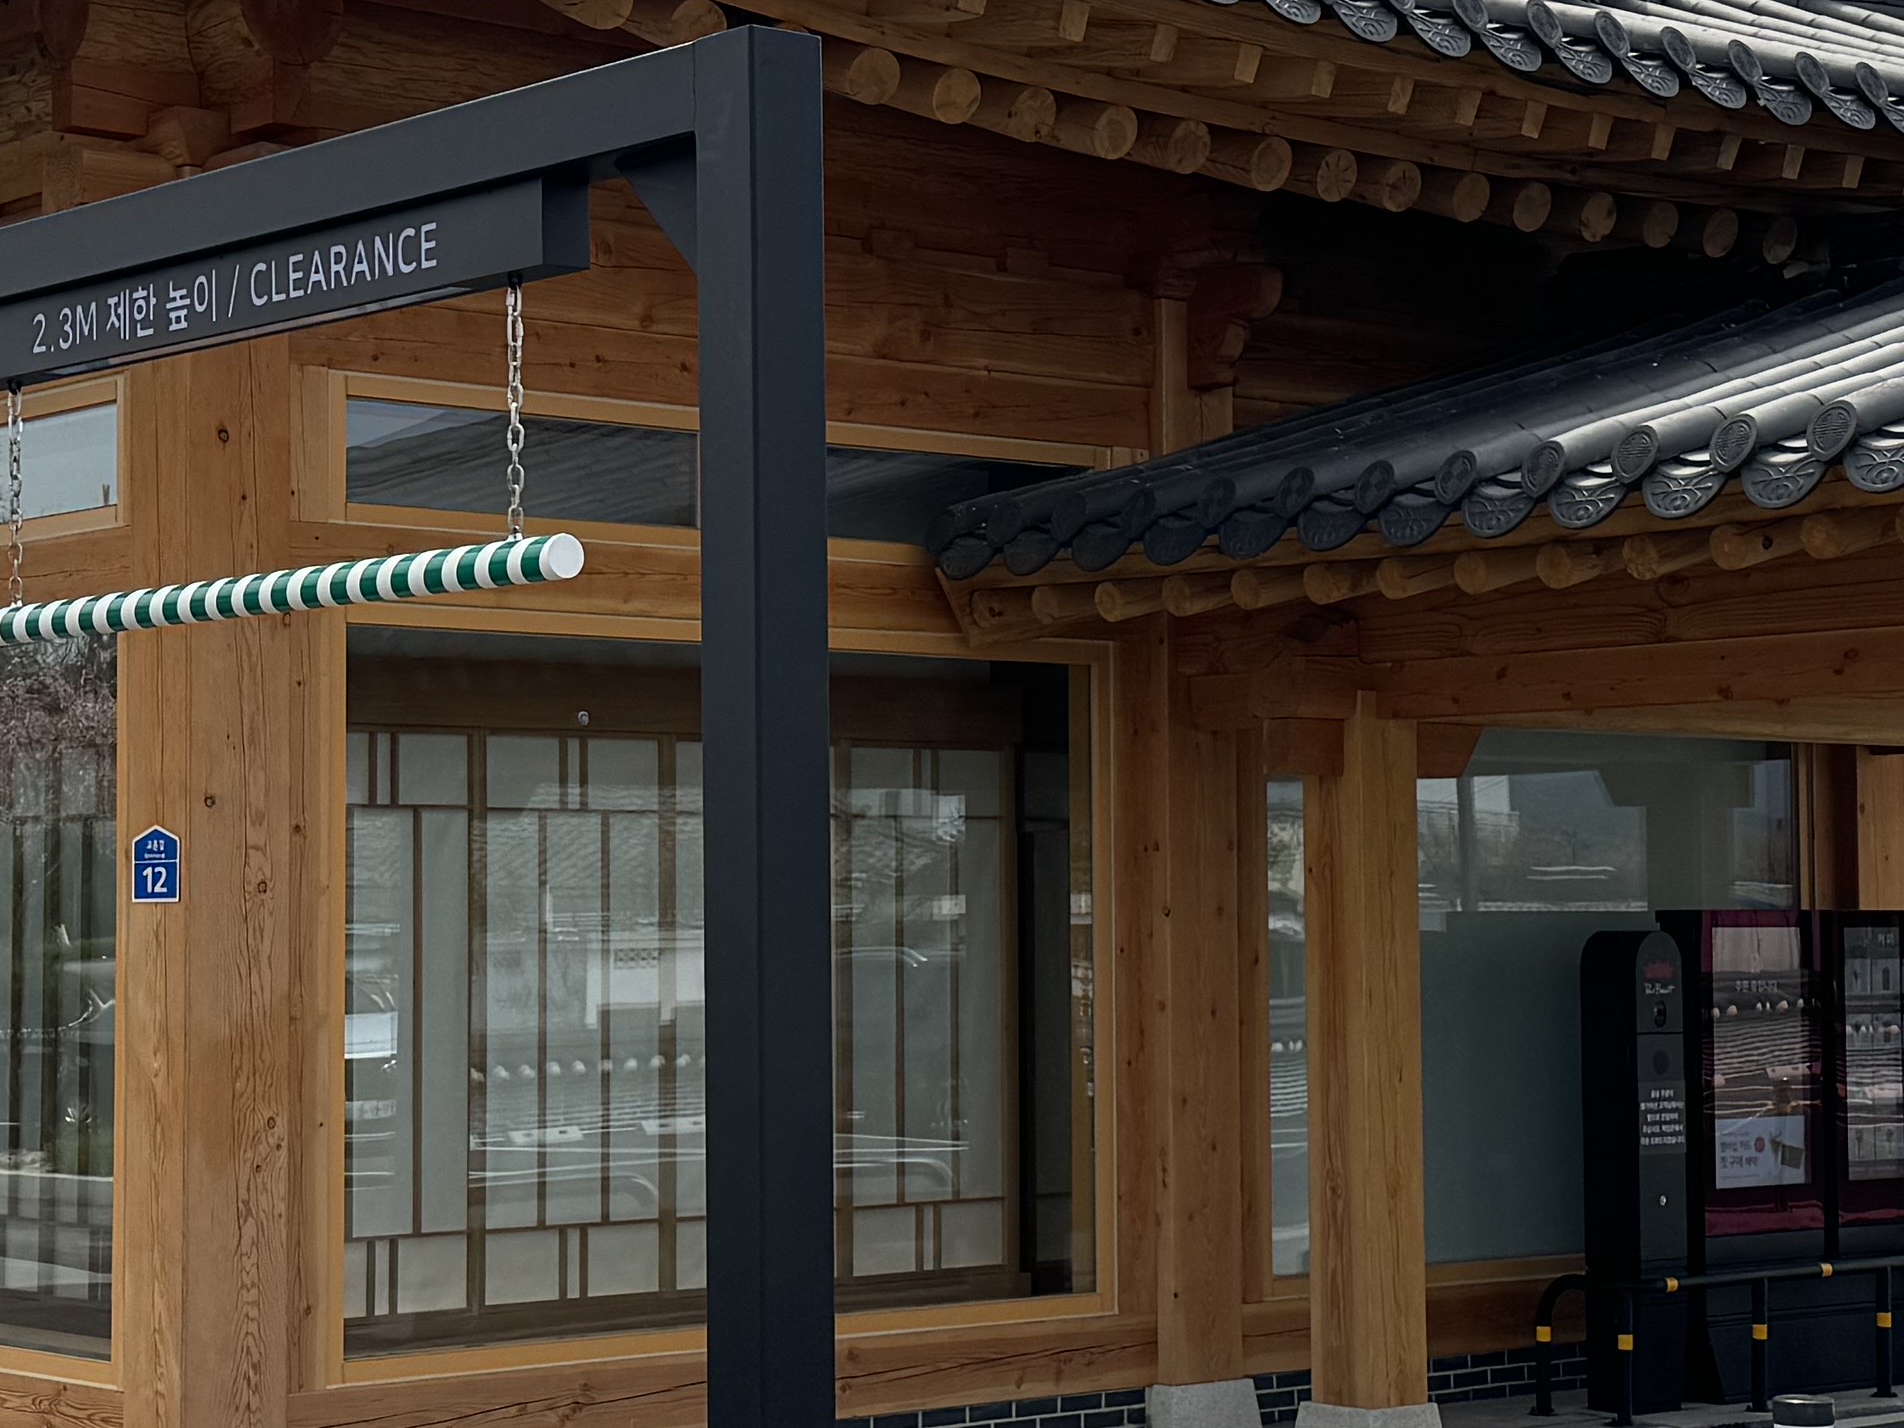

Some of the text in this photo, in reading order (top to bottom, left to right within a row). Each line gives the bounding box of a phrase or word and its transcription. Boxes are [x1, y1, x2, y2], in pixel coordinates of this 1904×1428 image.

[32, 221, 438, 354] 2.3M 제한 높이 / CLEARANCE
[142, 866, 168, 894] 12
